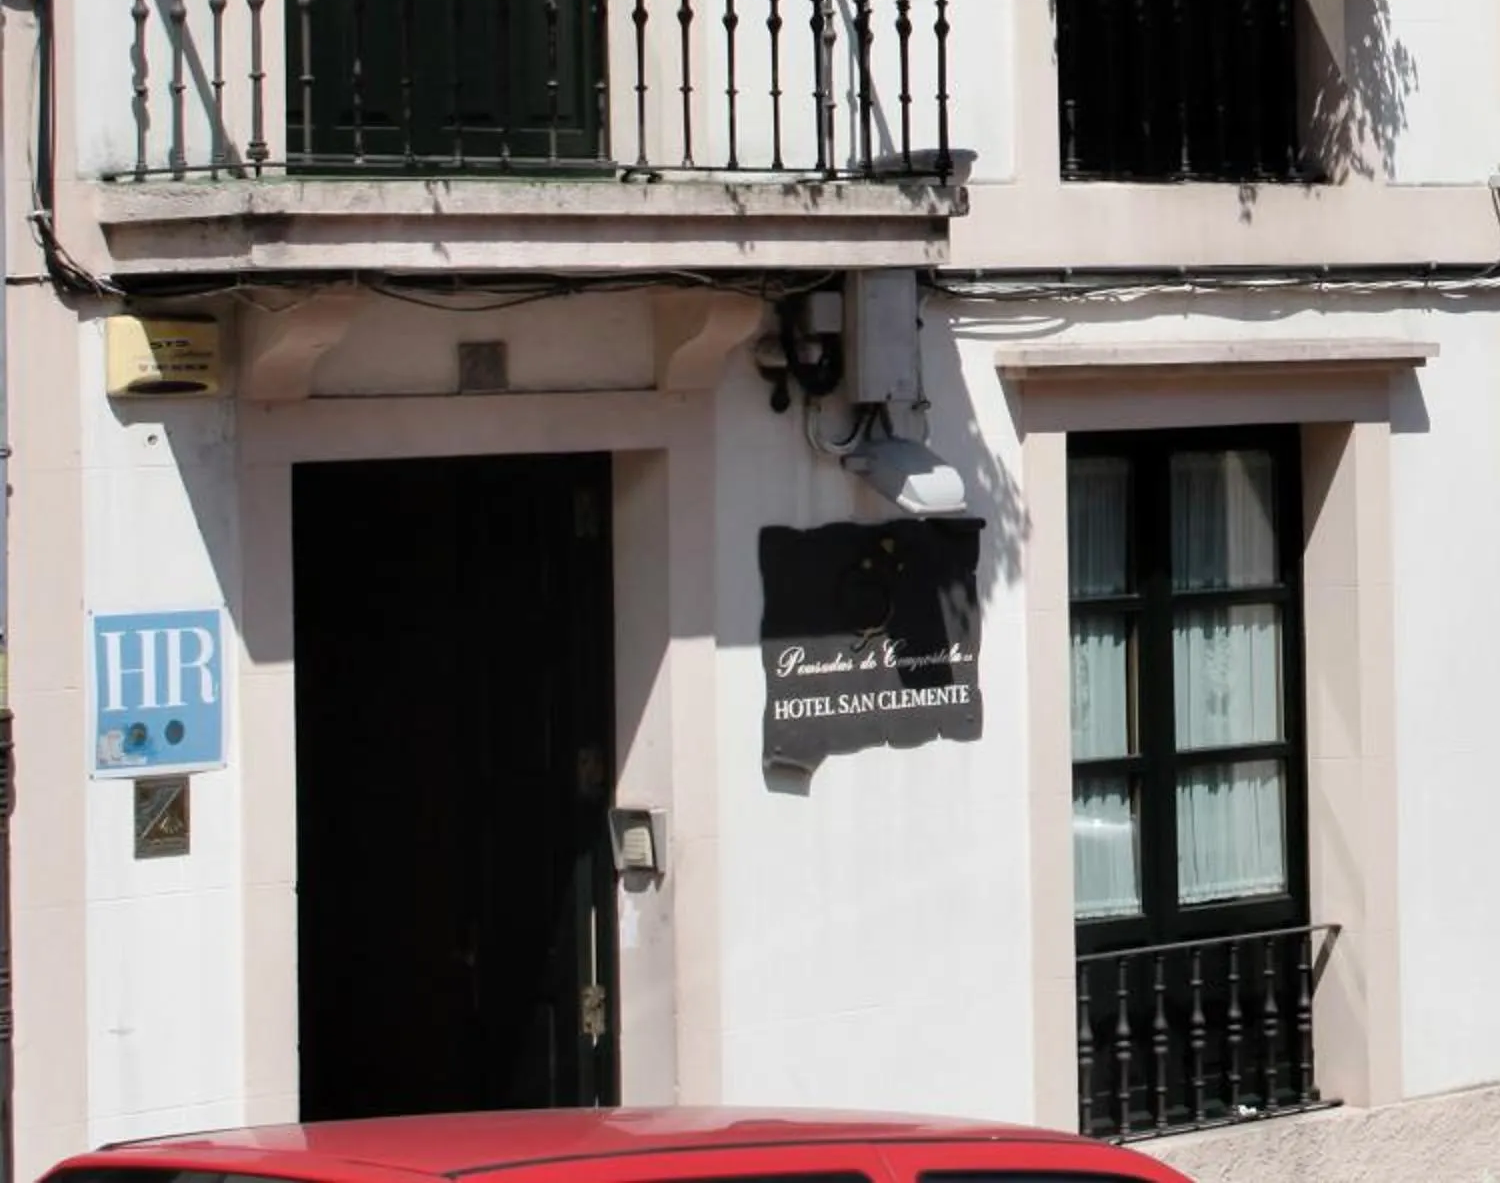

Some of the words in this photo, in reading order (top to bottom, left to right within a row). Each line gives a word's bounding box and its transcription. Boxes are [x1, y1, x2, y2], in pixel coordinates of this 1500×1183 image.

[100, 626, 219, 713] HR
[775, 697, 834, 720] HOTEL
[838, 692, 875, 715] SAN
[878, 684, 971, 711] CLEMENTE
